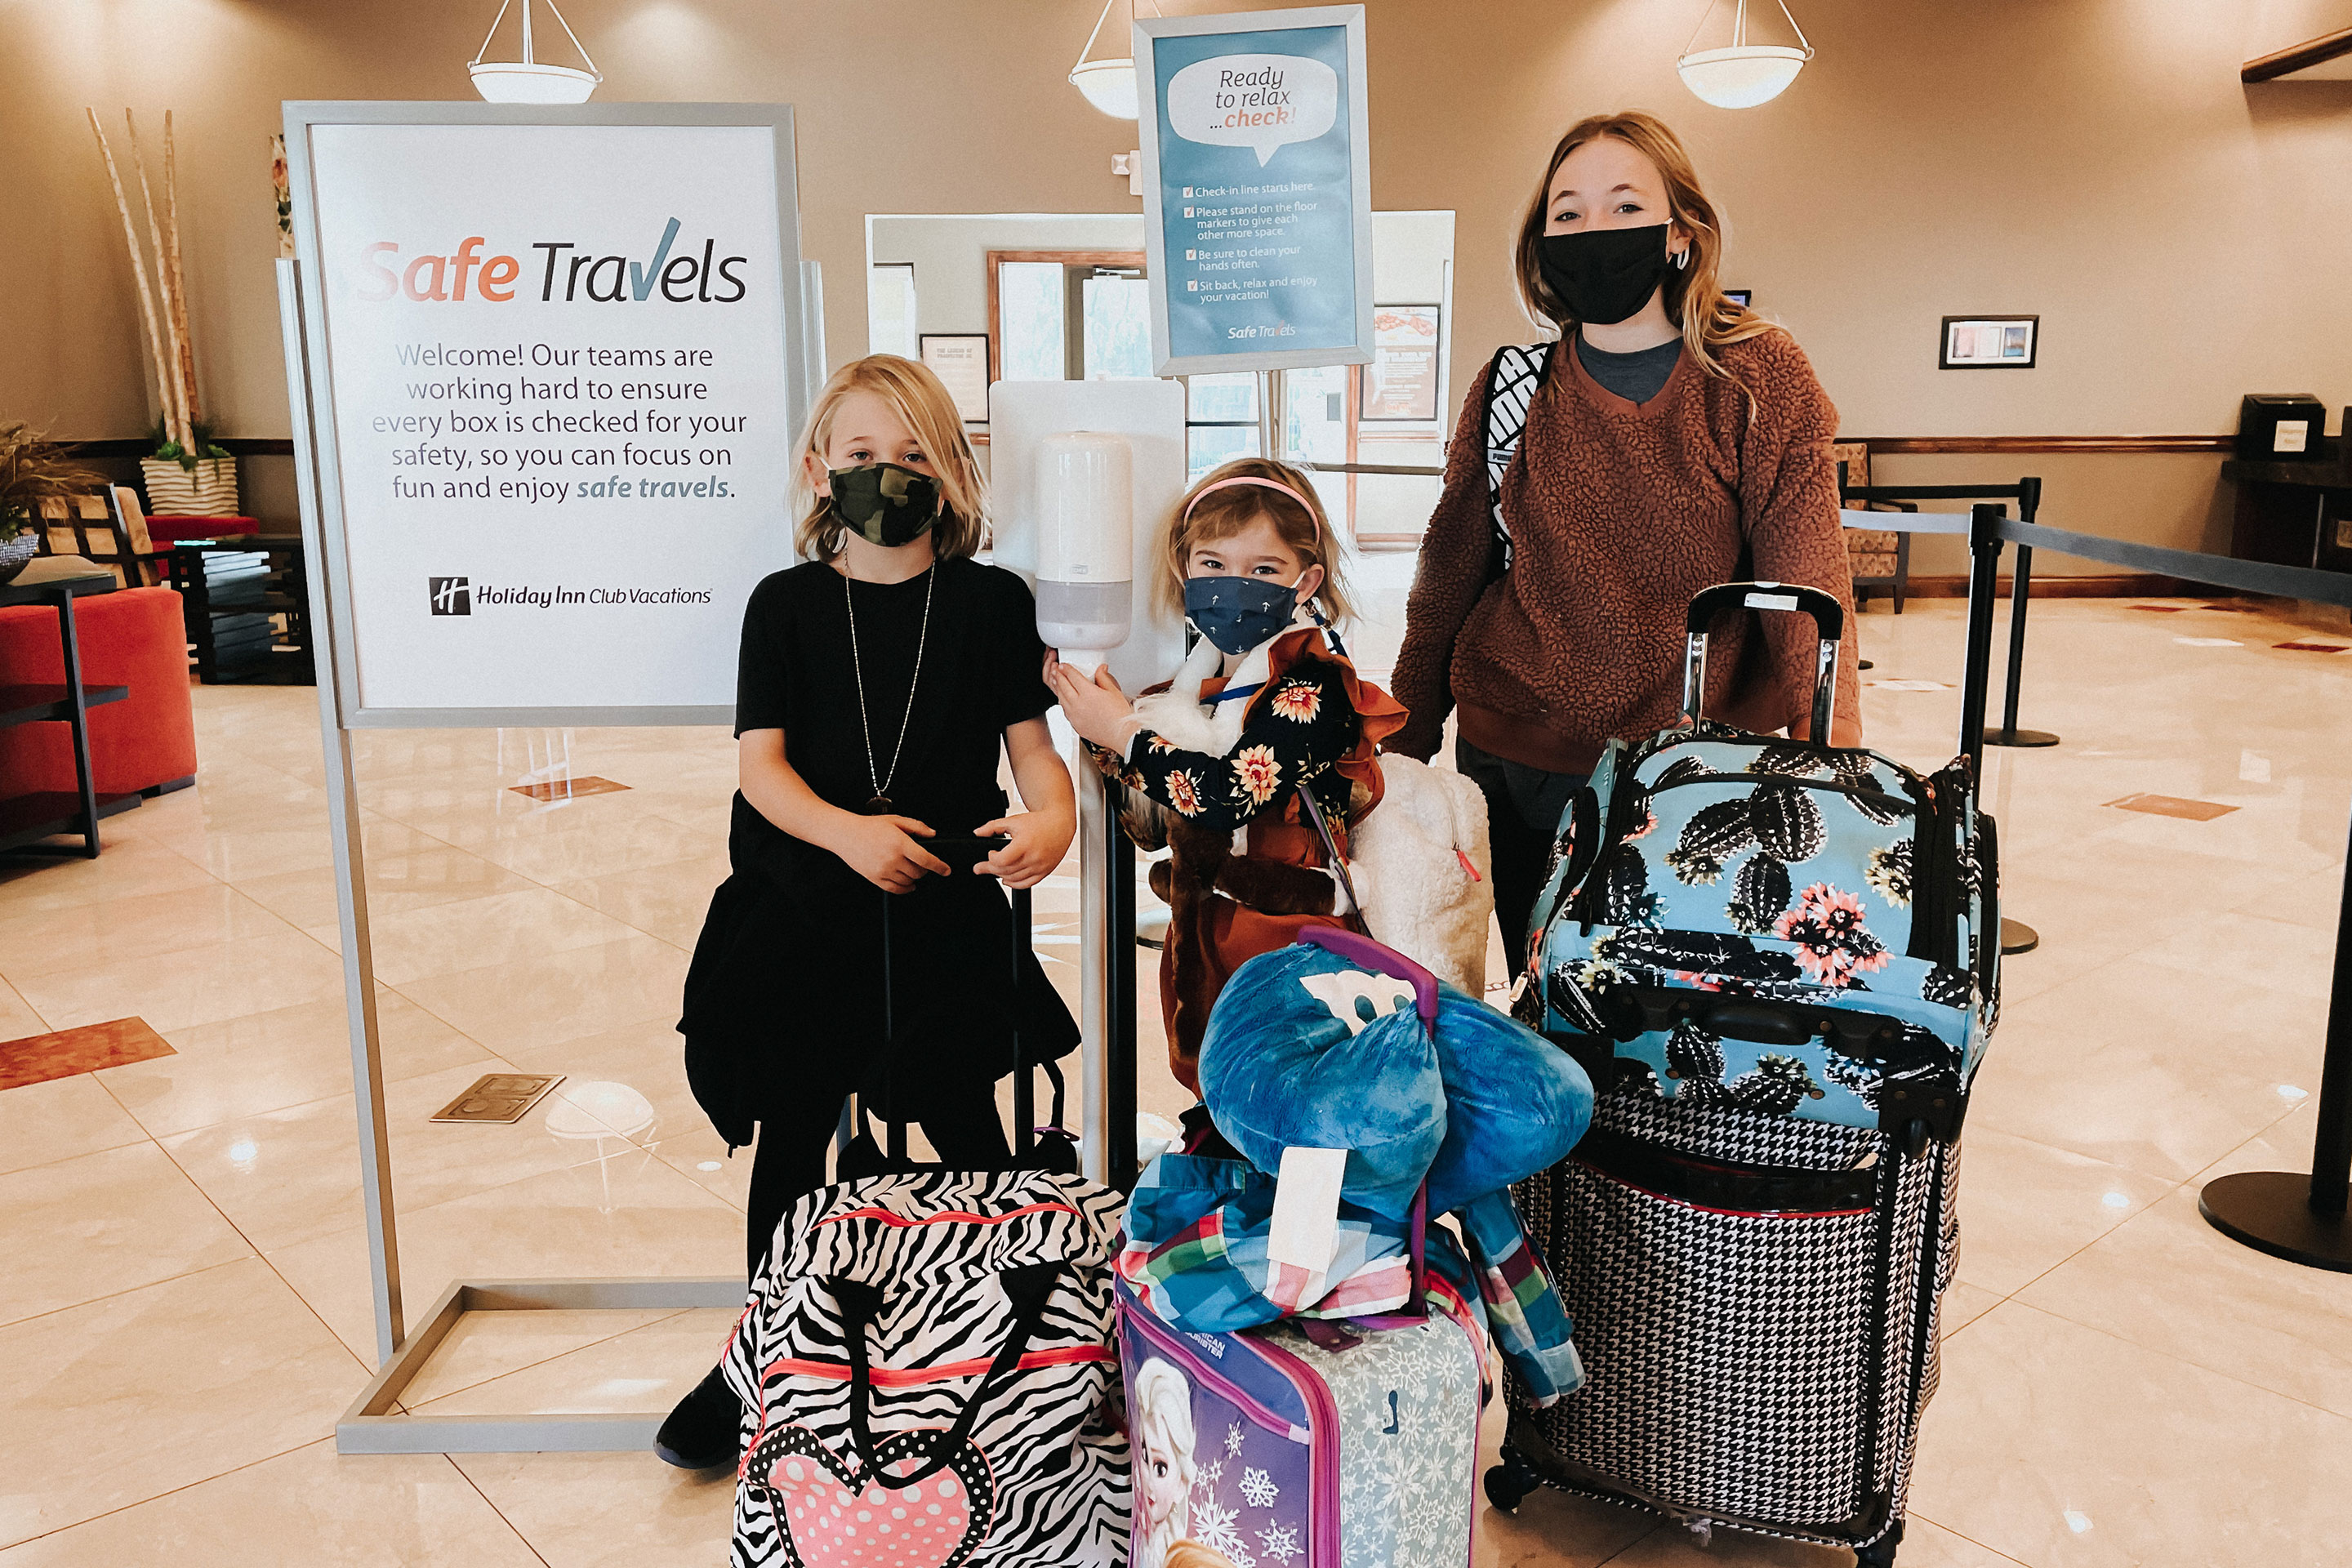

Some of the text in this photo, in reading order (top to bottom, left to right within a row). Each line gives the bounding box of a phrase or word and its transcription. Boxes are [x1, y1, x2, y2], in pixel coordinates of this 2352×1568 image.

[1220, 67, 1285, 89] Ready
[1215, 87, 1291, 109] to relax
[1196, 182, 1316, 197] Check-in line starts here.
[1196, 202, 1317, 216] Please stand on the floor
[1197, 214, 1298, 229] markers to give each
[1197, 228, 1285, 240] other more space.
[357, 216, 747, 303] Safe Travels
[1199, 247, 1301, 260] Be sure to clean your
[1200, 259, 1260, 271] hands often.
[1200, 276, 1317, 291] Sit back, relax and enjoy
[1200, 291, 1269, 305] your vacation!
[1228, 326, 1257, 339] Safe
[396, 343, 714, 367] Welcome! Our teams are
[407, 376, 708, 405] working hard to ensure
[373, 409, 747, 439] every box is checked for your
[392, 443, 732, 471] safety, so you can focus on
[392, 474, 736, 504] fun and enjoy safe travels.
[476, 586, 551, 608] Holiday
[556, 586, 586, 604] Inn
[590, 588, 626, 604] Club
[630, 588, 711, 604] Vacations
[1200, 1333, 1225, 1352] ICAN
